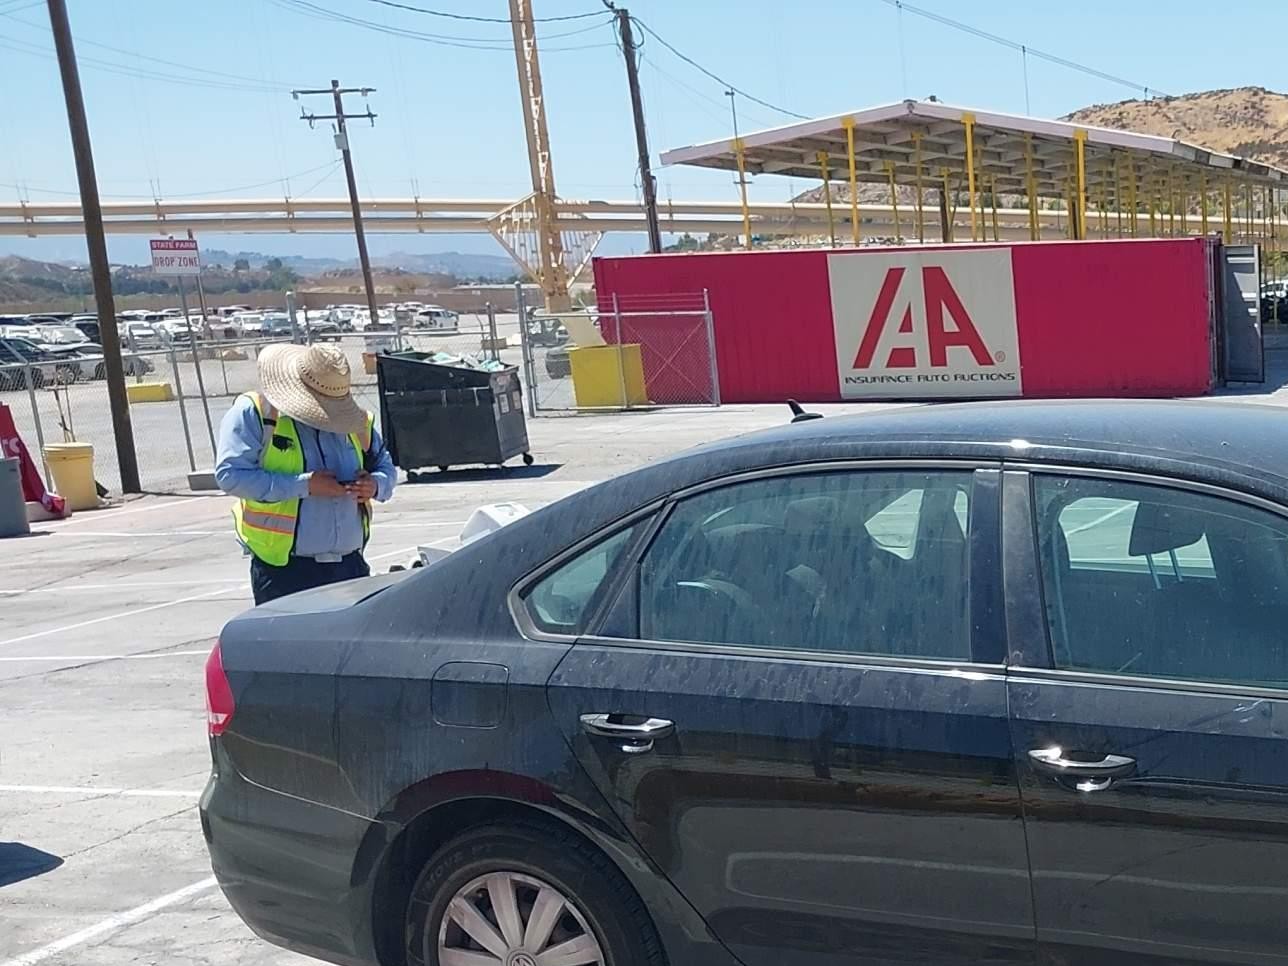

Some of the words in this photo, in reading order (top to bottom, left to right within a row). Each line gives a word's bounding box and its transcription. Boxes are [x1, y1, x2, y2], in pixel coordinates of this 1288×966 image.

[151, 241, 174, 249] STATE
[175, 241, 196, 249] FARM
[154, 256, 175, 267] DROP
[178, 256, 198, 267] ZONE
[852, 265, 995, 369] IAA
[844, 374, 913, 385] INSURANCE
[917, 373, 951, 383] AUTO
[953, 371, 1016, 382] AUCTIONS
